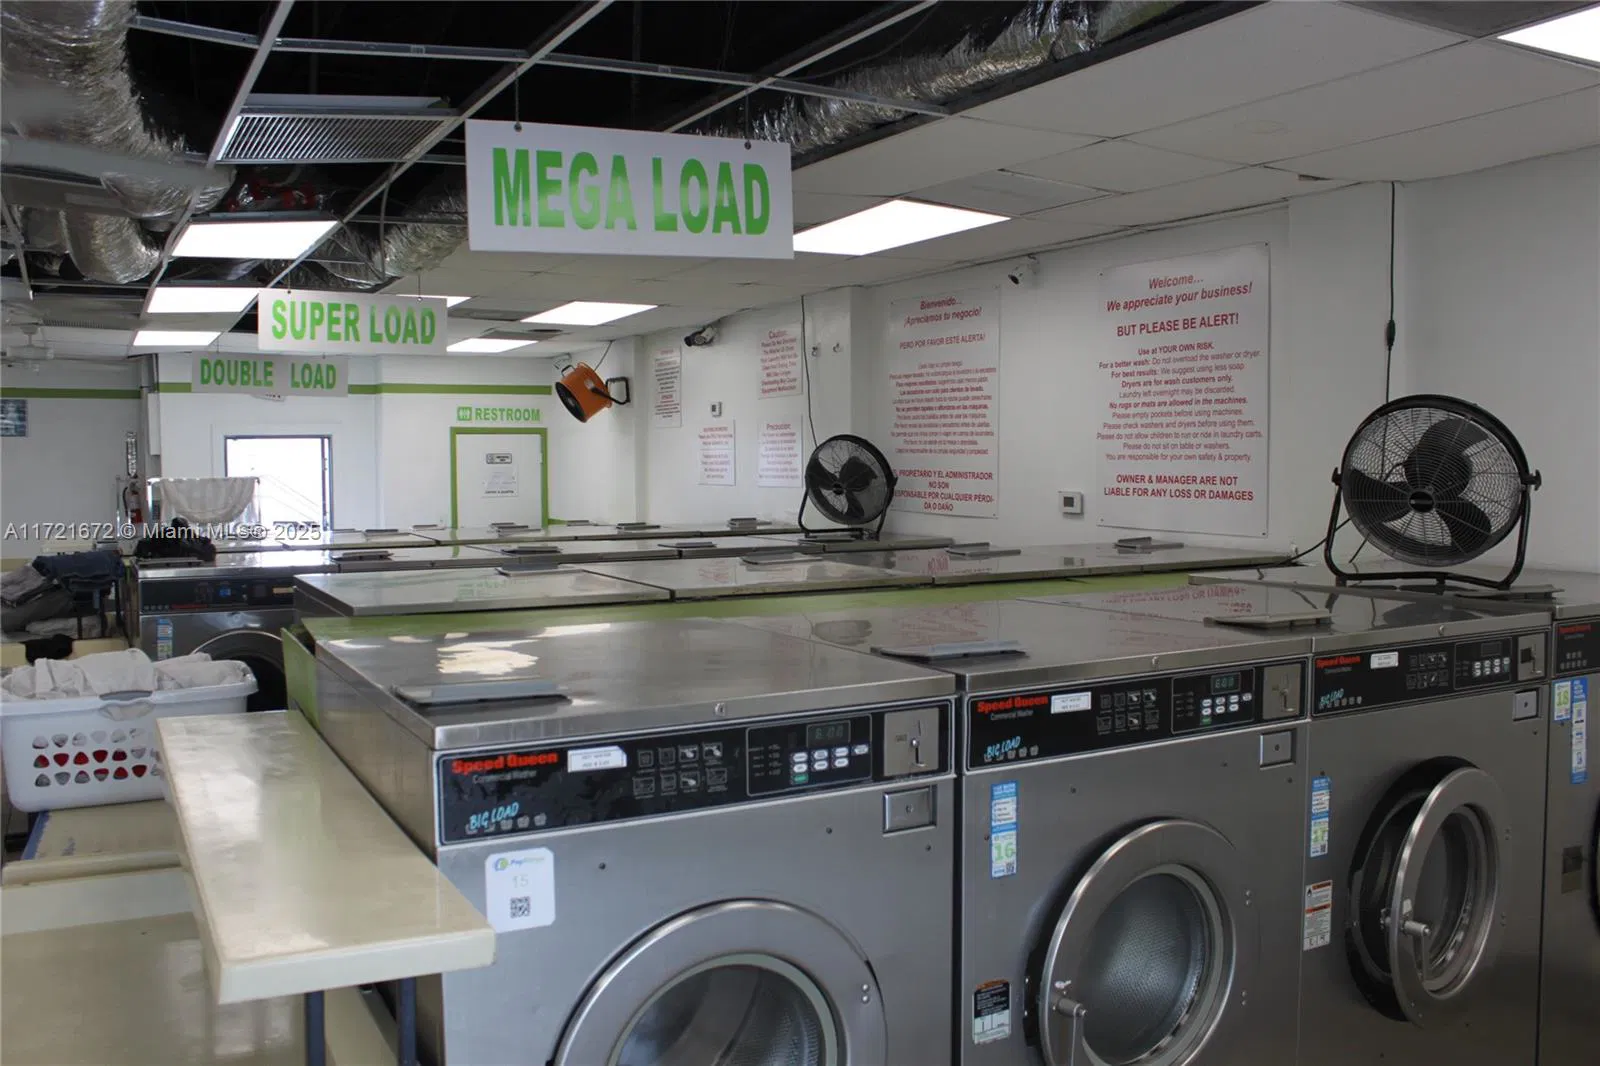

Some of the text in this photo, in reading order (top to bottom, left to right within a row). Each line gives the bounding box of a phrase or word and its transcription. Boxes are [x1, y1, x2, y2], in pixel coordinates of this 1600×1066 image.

[492, 146, 771, 236] MEGA LOAD
[1149, 274, 1203, 289] Welcome...
[1107, 282, 1253, 312] We appreciate your business!
[271, 299, 436, 346] SUPER LOAD
[1117, 313, 1239, 337] BUT PLEASE BE ALERT!
[1158, 345, 1178, 354] YOUR
[1178, 344, 1196, 352] OWN
[1210, 352, 1234, 360] washer
[200, 358, 337, 390] DOUBLE LOAD
[1172, 367, 1194, 376] suggest
[1122, 380, 1142, 389] Dryers
[1182, 376, 1216, 384] customers
[1169, 398, 1193, 406] allowed
[475, 408, 540, 421] RESTROOM
[1178, 420, 1196, 429] dryers
[1198, 420, 1217, 428] before
[1218, 420, 1236, 428] using
[1220, 430, 1244, 440] laundry
[1127, 453, 1159, 462] responsible
[1170, 454, 1182, 462] your
[1198, 452, 1217, 462] safety
[945, 471, 993, 480] ADMINISTRADOR
[1116, 474, 1238, 486] OWNER & MANAGER ARE NOT
[1104, 487, 1254, 500] LIABLE FOR ANY LOSS OR DAMAGES
[977, 698, 1012, 714] Speed
[1014, 696, 1048, 708] Queen
[986, 736, 1020, 758] BIG LOAD
[452, 754, 504, 775] Speed
[507, 752, 558, 768] Queen
[469, 802, 520, 831] BIG LOAD
[994, 842, 1016, 862] 16
